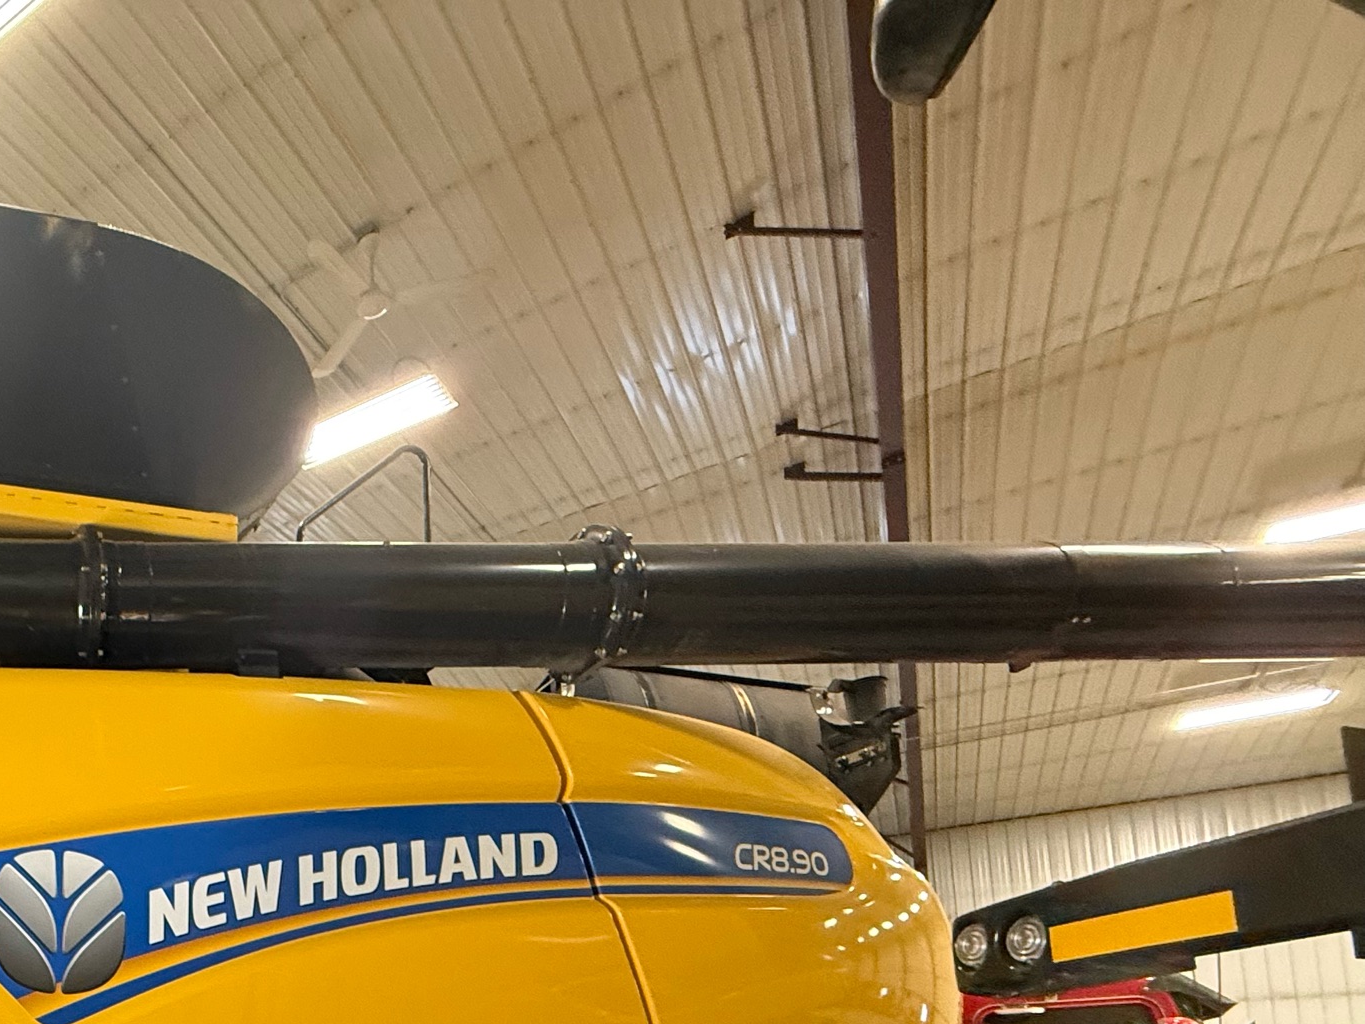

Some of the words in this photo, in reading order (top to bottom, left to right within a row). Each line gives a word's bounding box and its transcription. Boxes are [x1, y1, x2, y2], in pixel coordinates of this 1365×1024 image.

[148, 859, 283, 945] NEW
[298, 832, 559, 906] HOLLAND
[735, 843, 830, 876] CR8.90
